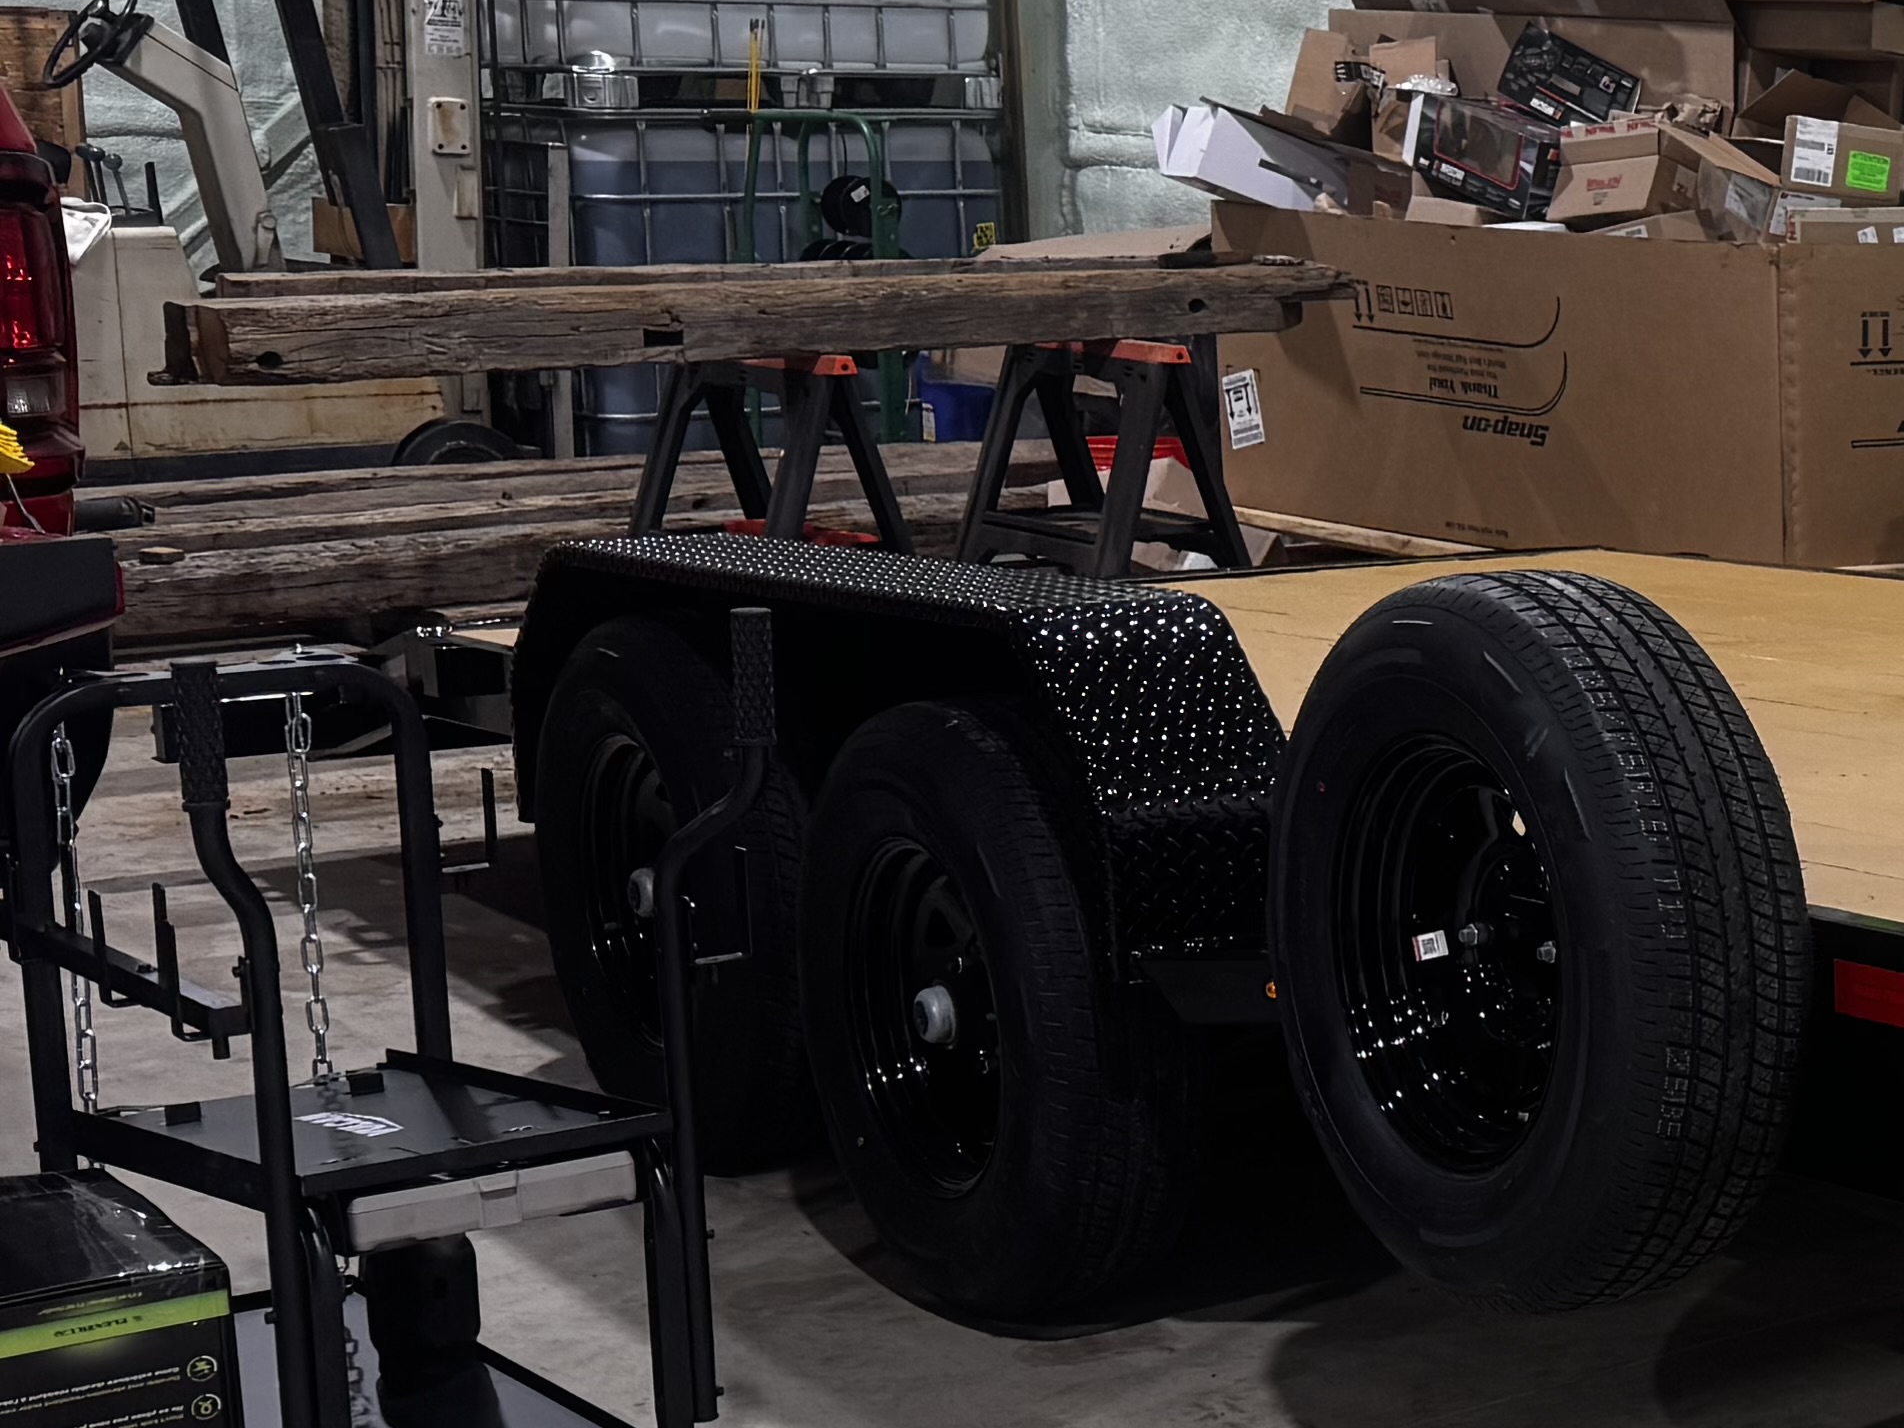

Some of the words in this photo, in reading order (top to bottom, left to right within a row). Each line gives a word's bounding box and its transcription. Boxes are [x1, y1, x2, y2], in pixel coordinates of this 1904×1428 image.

[1429, 377, 1455, 394] You!
[1461, 382, 1499, 399] Thank
[1461, 416, 1549, 447] Snap-on
